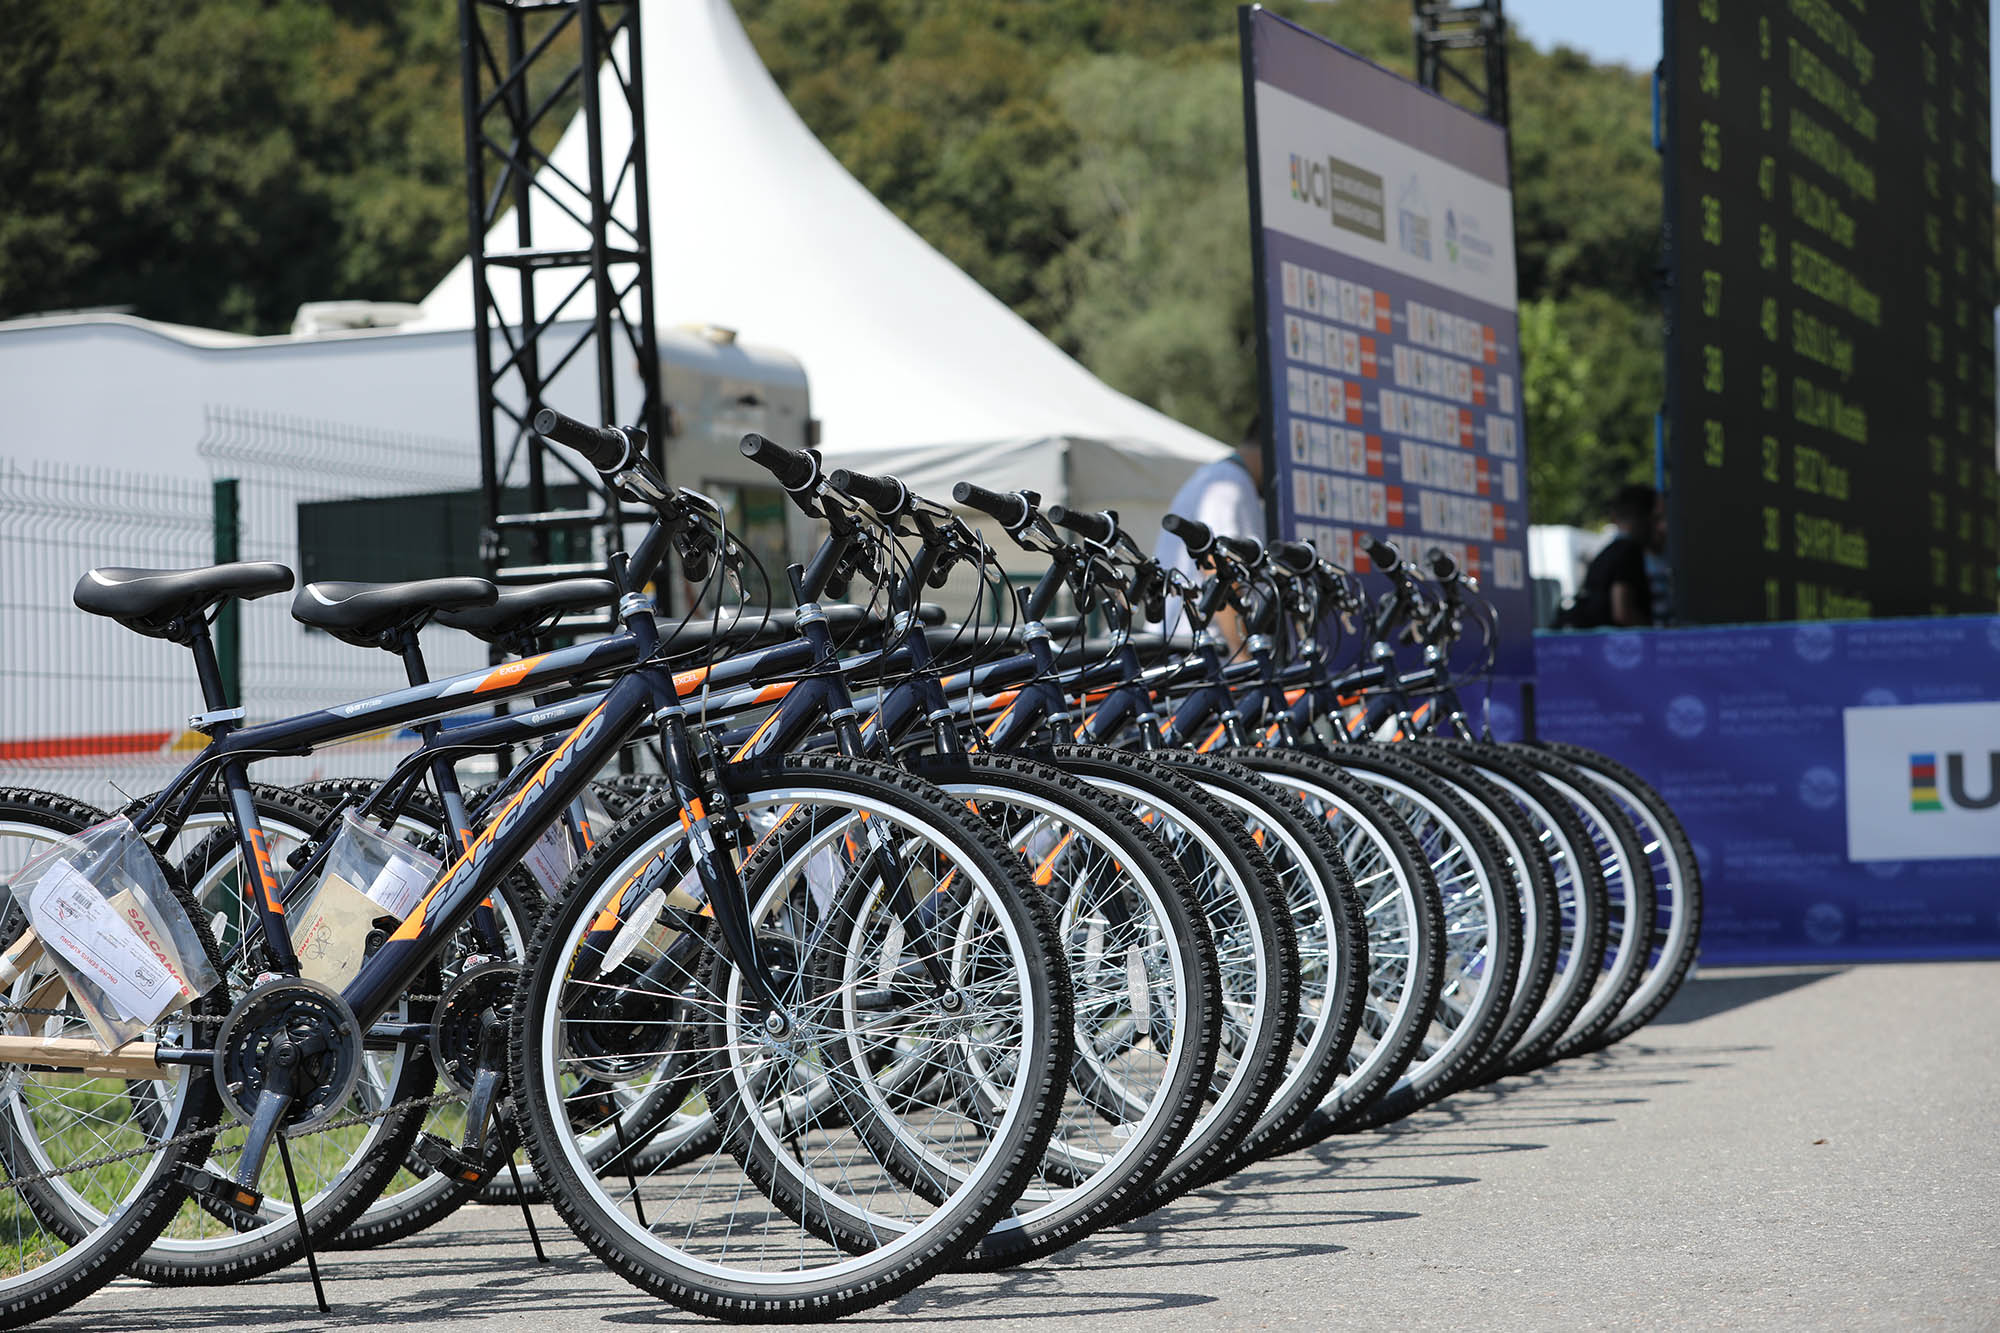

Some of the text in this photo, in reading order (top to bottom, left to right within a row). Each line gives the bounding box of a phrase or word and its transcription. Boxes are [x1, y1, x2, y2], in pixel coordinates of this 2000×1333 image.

[1297, 155, 1328, 209] UCI
[1656, 637, 1772, 651] METROPOLITAN
[499, 661, 527, 677] EXCEL
[673, 672, 699, 686] EXCEL
[1719, 705, 1836, 720] METROPOLITAN
[424, 711, 609, 927] SALCANO
[60, 935, 82, 955] KUPONU
[298, 916, 324, 957] SALCANO
[98, 966, 118, 985] ONLINE
